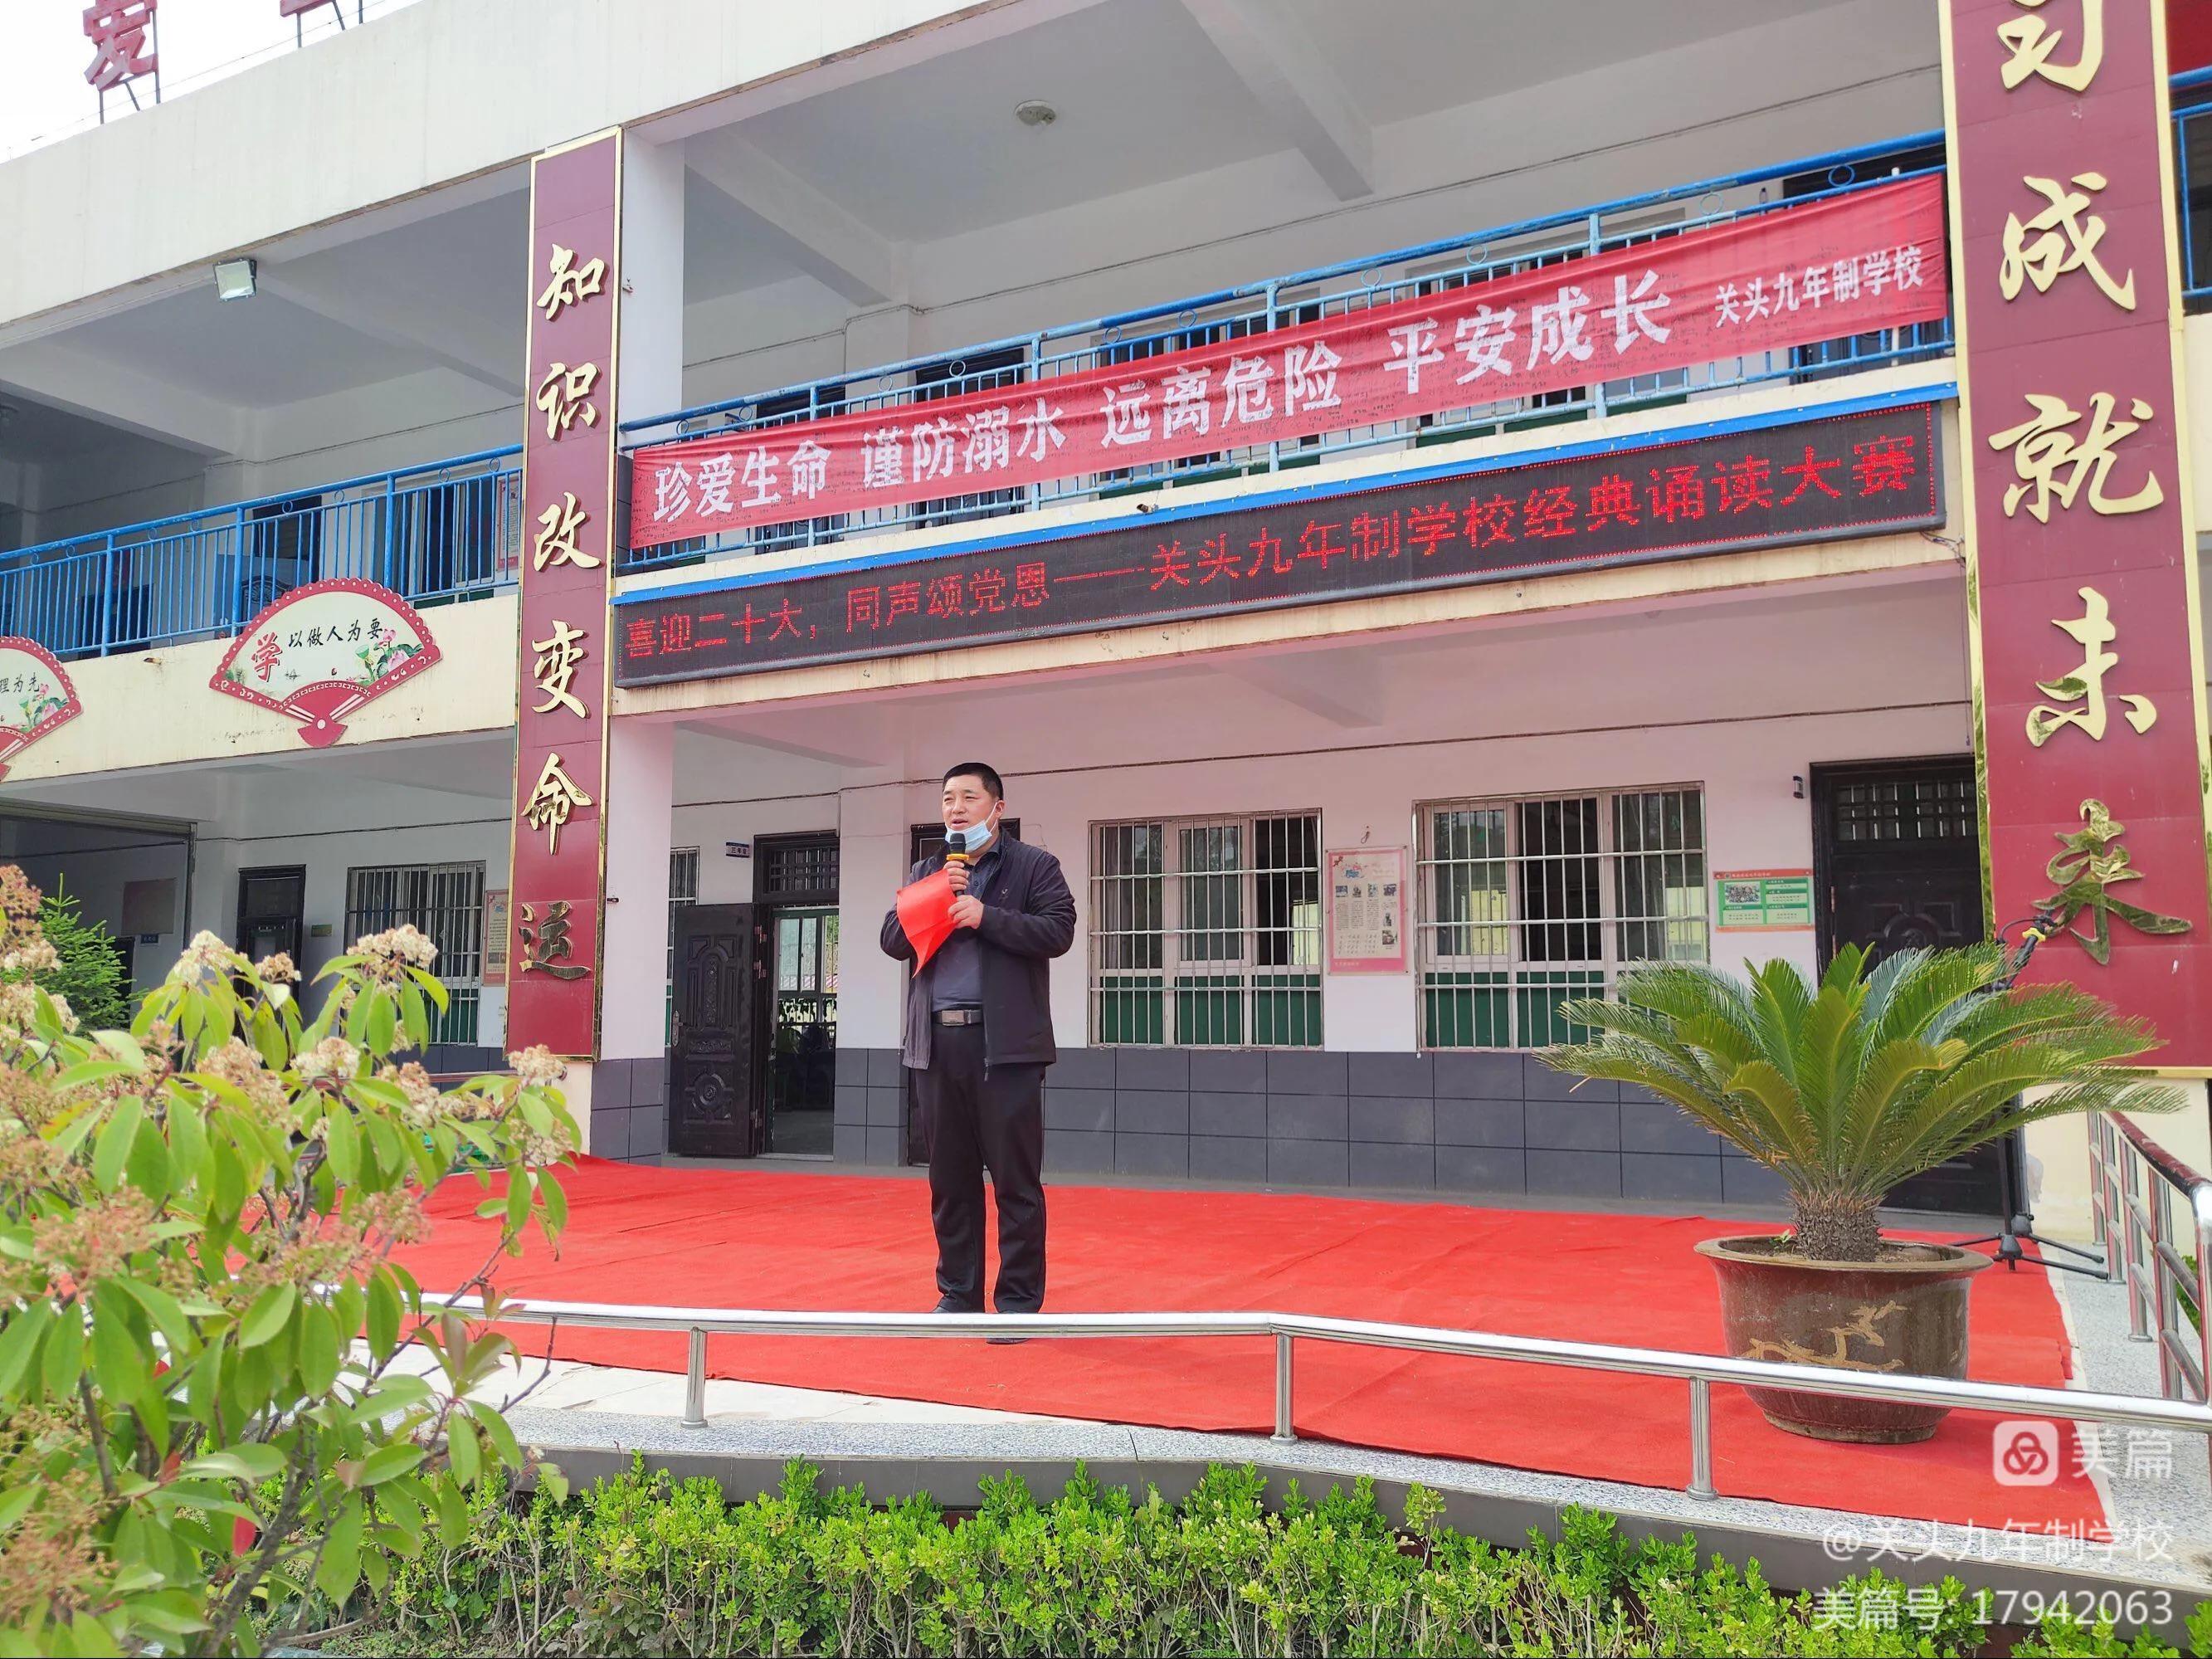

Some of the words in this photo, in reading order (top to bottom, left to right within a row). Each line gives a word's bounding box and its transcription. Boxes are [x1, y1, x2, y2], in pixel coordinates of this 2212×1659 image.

[517, 242, 607, 982] 知识改变命运
[653, 438, 831, 523] 珍爱生命
[860, 398, 1067, 490] 谨防溺水
[1100, 339, 1342, 448] 远离危险
[1383, 269, 1672, 394] 平安成长
[1714, 246, 1923, 327] 关头九年制学校
